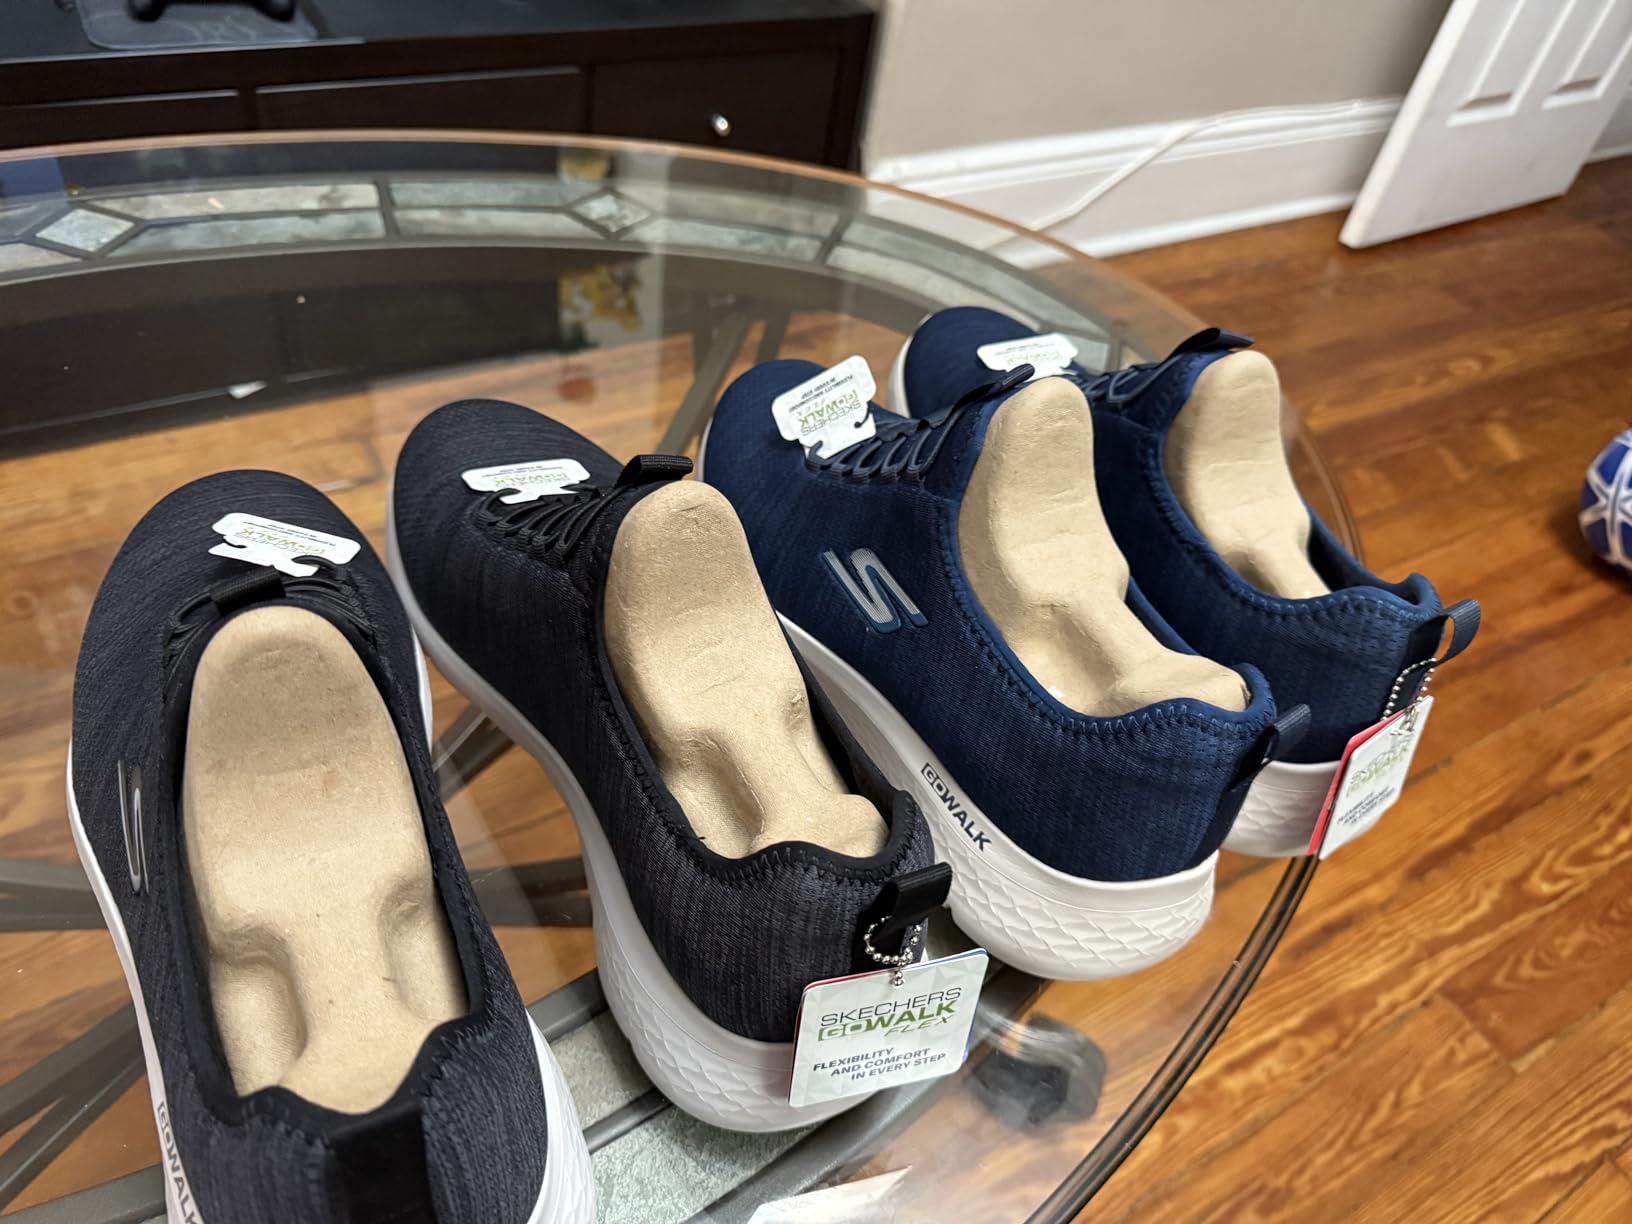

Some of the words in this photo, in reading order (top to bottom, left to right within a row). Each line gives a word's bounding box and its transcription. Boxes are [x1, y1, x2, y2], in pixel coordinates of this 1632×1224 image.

[921, 762, 992, 852] GOWALK
[817, 999, 958, 1042] GOWALK
[820, 987, 962, 1027] SKECHERS
[884, 1013, 955, 1037] FLEX
[813, 1047, 894, 1071] FLEXIBILITY
[831, 1063, 861, 1076] AND
[864, 1048, 931, 1069] COMFORT
[851, 1071, 865, 1080] IN
[869, 1061, 910, 1077] EVERY
[914, 1053, 946, 1067] STEP
